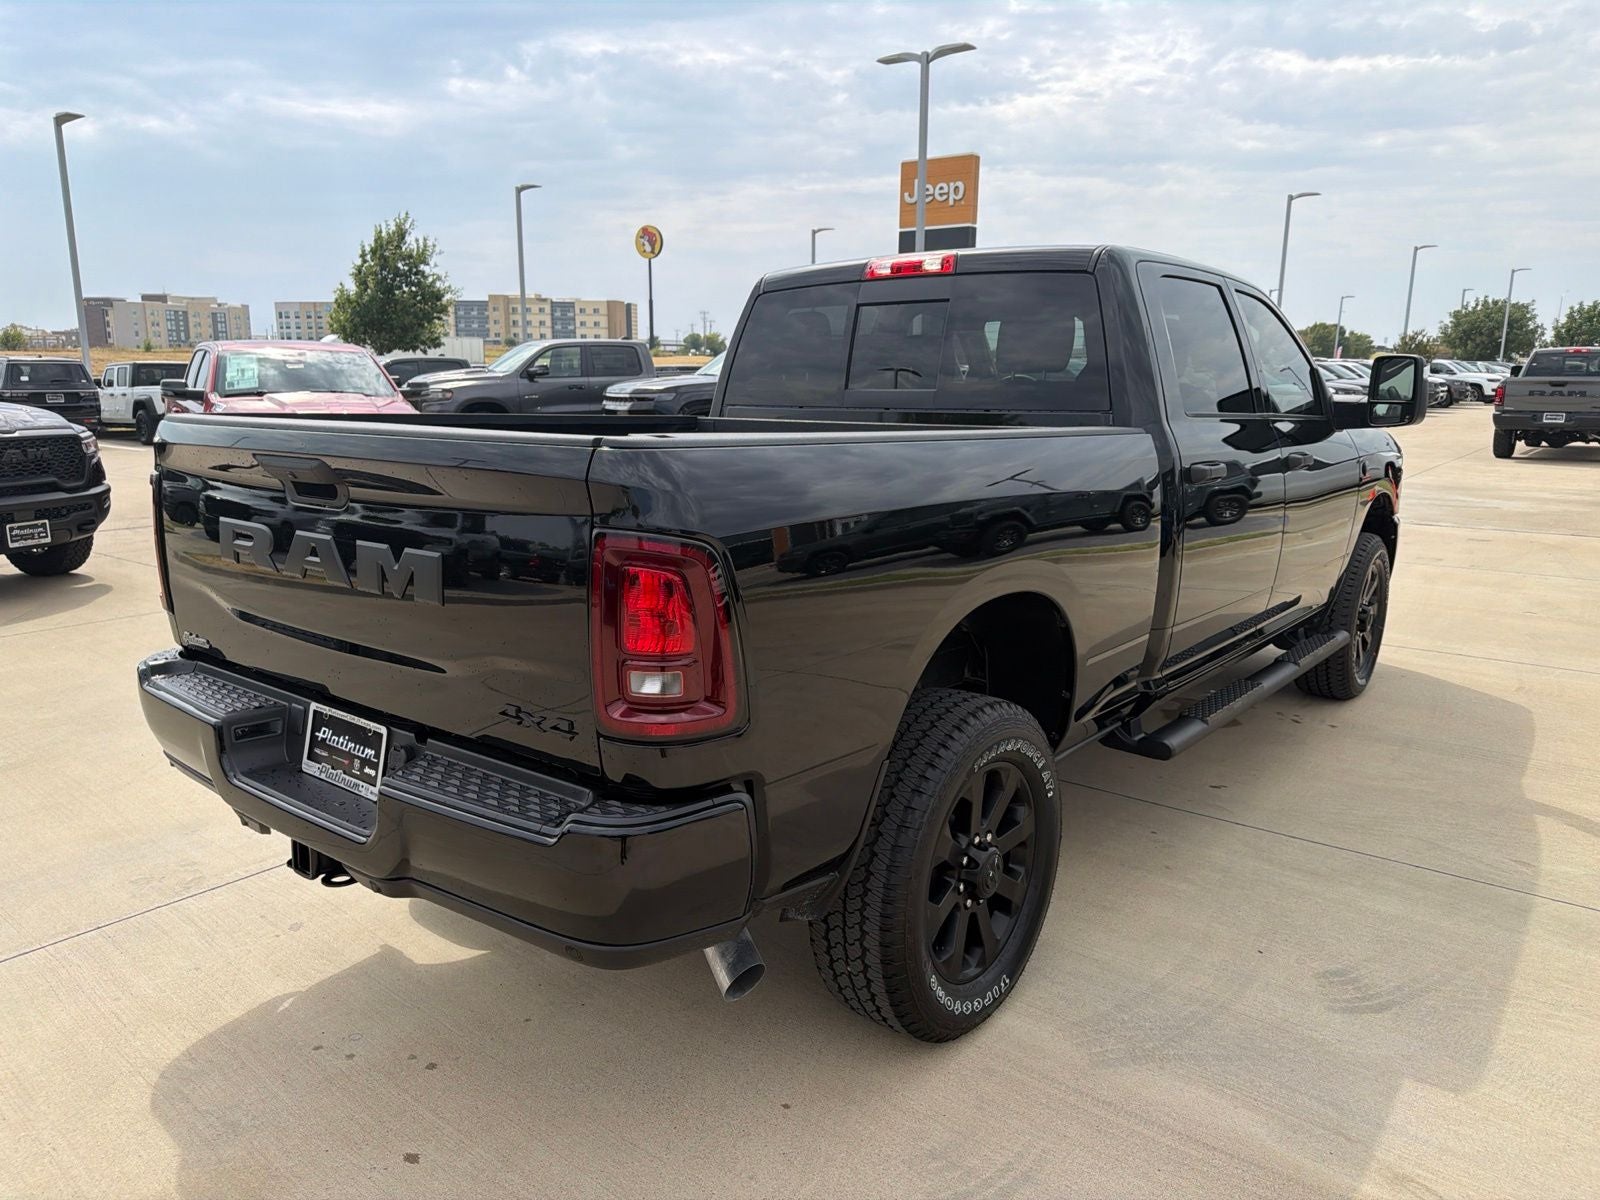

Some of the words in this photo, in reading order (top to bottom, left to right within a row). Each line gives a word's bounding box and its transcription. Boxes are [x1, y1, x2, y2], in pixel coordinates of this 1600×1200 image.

[904, 178, 965, 206] Jeep
[1, 448, 49, 463] AM
[219, 516, 444, 606] RAM
[315, 727, 378, 762] Platinum
[320, 764, 362, 793] Platinum
[364, 766, 376, 777] Jeep
[929, 974, 1010, 1015] Firestone
